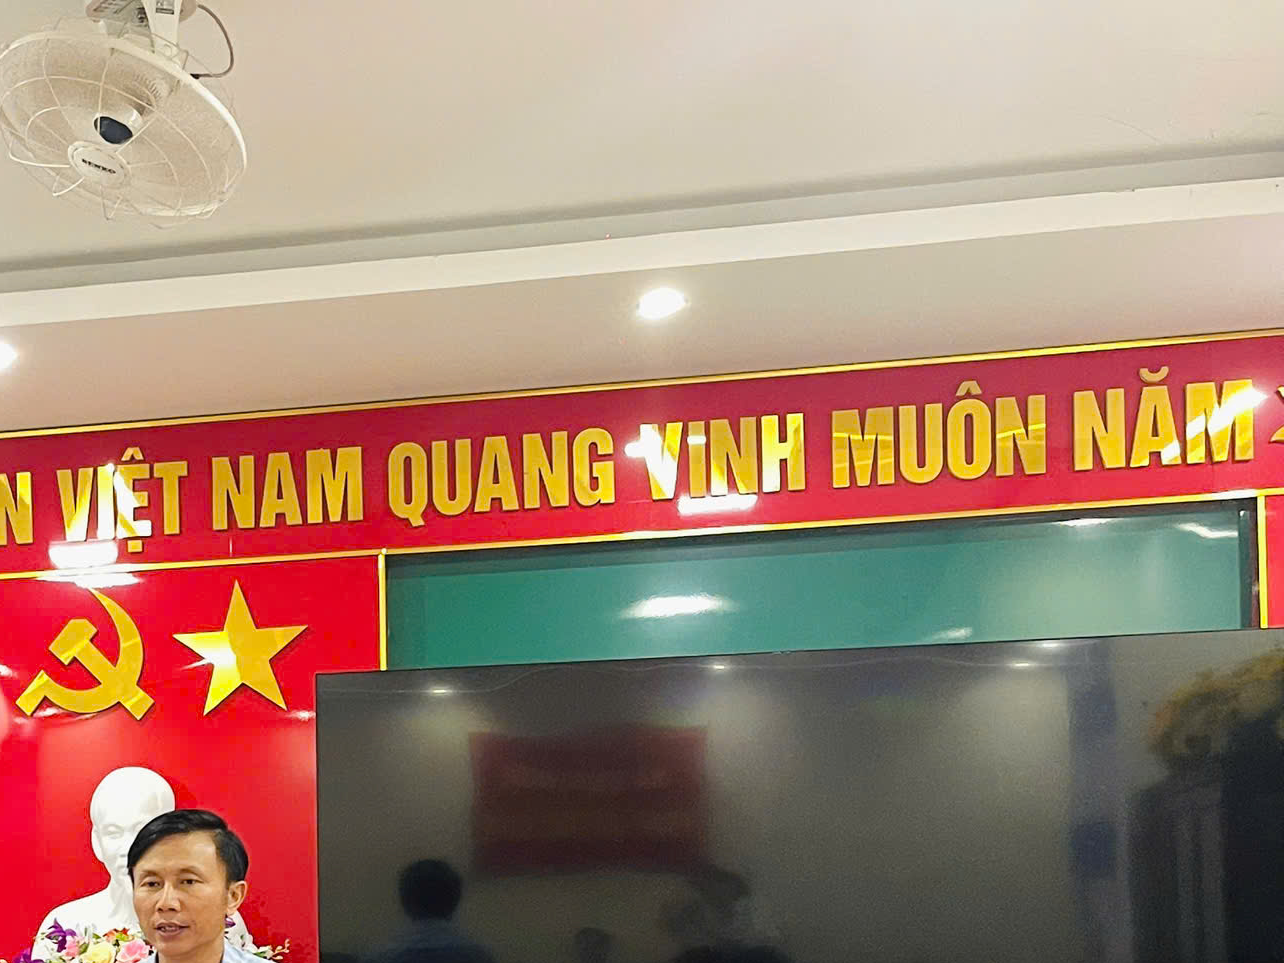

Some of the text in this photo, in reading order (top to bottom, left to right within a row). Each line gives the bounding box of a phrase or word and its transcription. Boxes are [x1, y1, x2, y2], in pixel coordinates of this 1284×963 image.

[57, 447, 188, 553] VIỆT
[212, 446, 363, 530] NAM
[388, 427, 616, 527] QUANG
[639, 412, 806, 500] VINH
[831, 380, 1047, 488] MUÔN
[1073, 365, 1255, 471] NĂM
